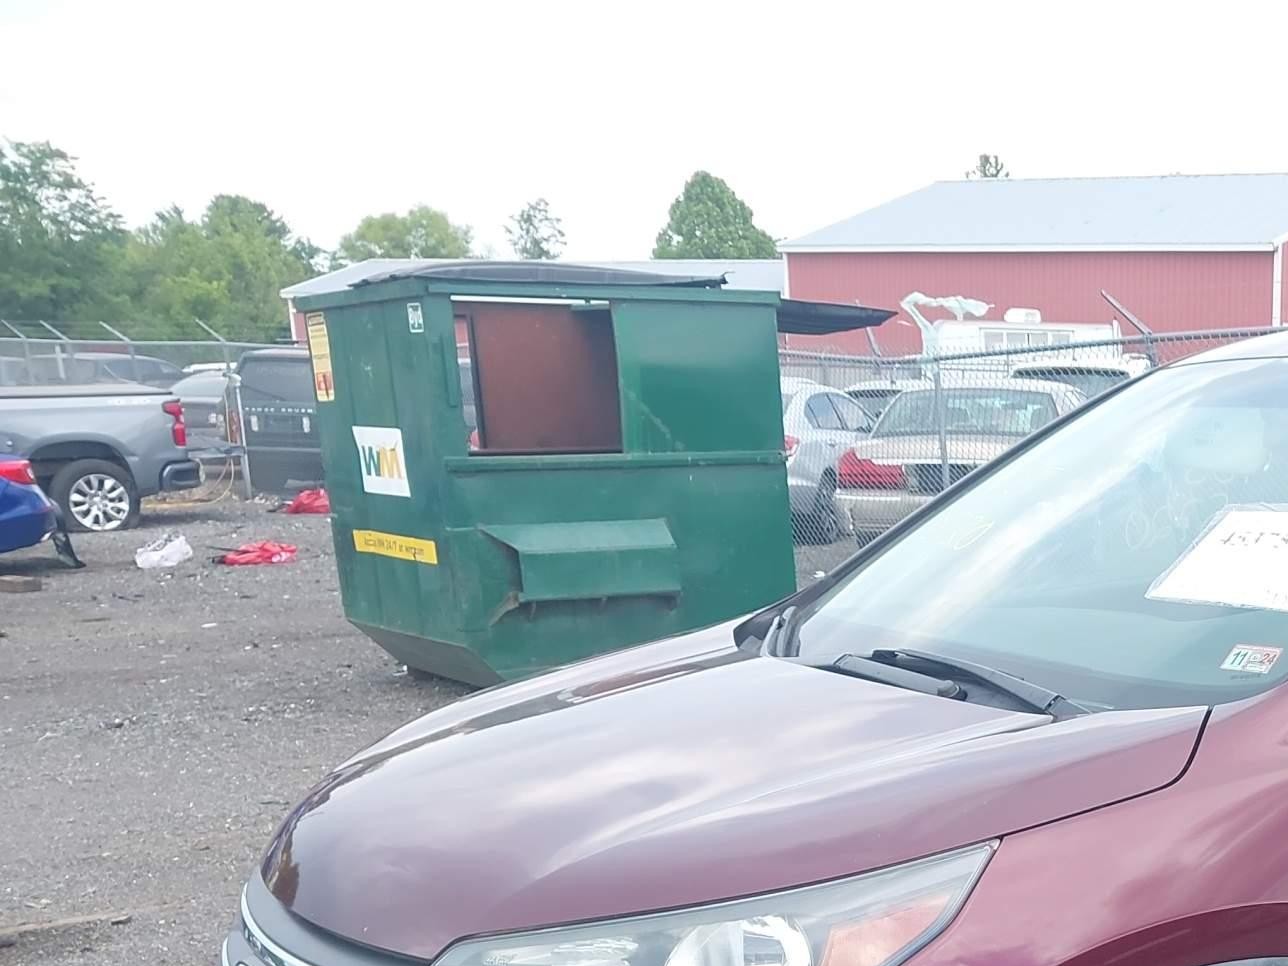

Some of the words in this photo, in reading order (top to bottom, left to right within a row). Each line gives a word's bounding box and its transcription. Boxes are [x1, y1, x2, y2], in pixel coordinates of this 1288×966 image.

[361, 445, 403, 480] WM
[1230, 650, 1249, 666] 11
[1262, 652, 1277, 665] 24
